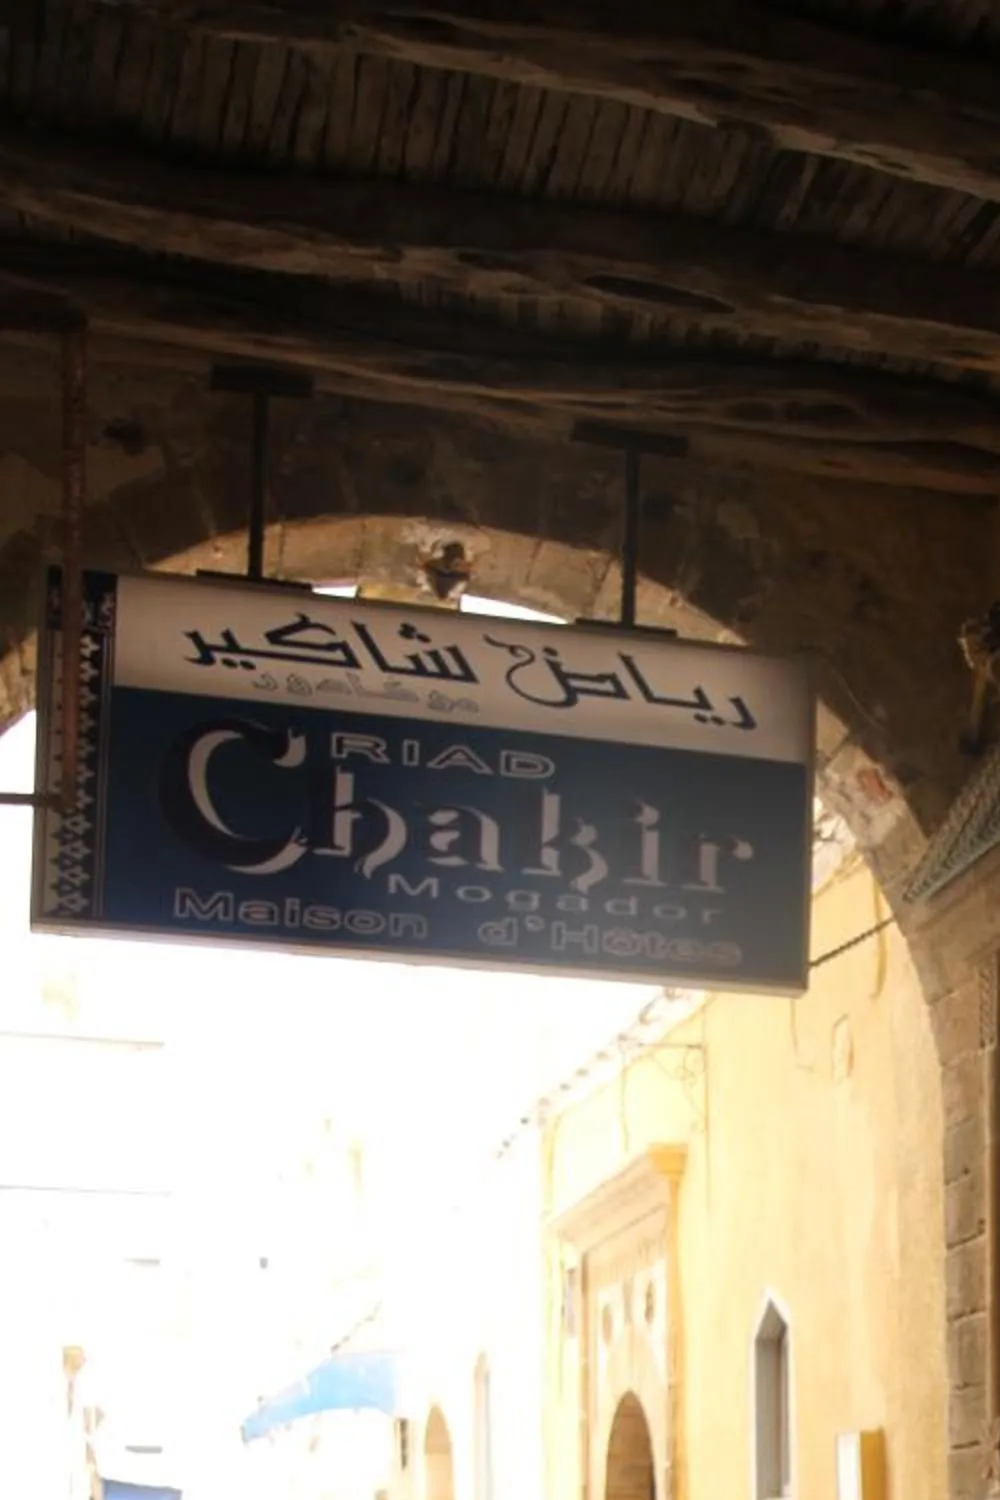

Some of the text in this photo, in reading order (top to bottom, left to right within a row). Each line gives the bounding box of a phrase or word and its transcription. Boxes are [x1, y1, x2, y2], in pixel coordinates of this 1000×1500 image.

[183, 611, 757, 730] رياض شاكير
[331, 732, 556, 780] RIAD
[160, 718, 755, 894] Chakir
[173, 887, 429, 939] Maison
[387, 874, 723, 924] Mogador
